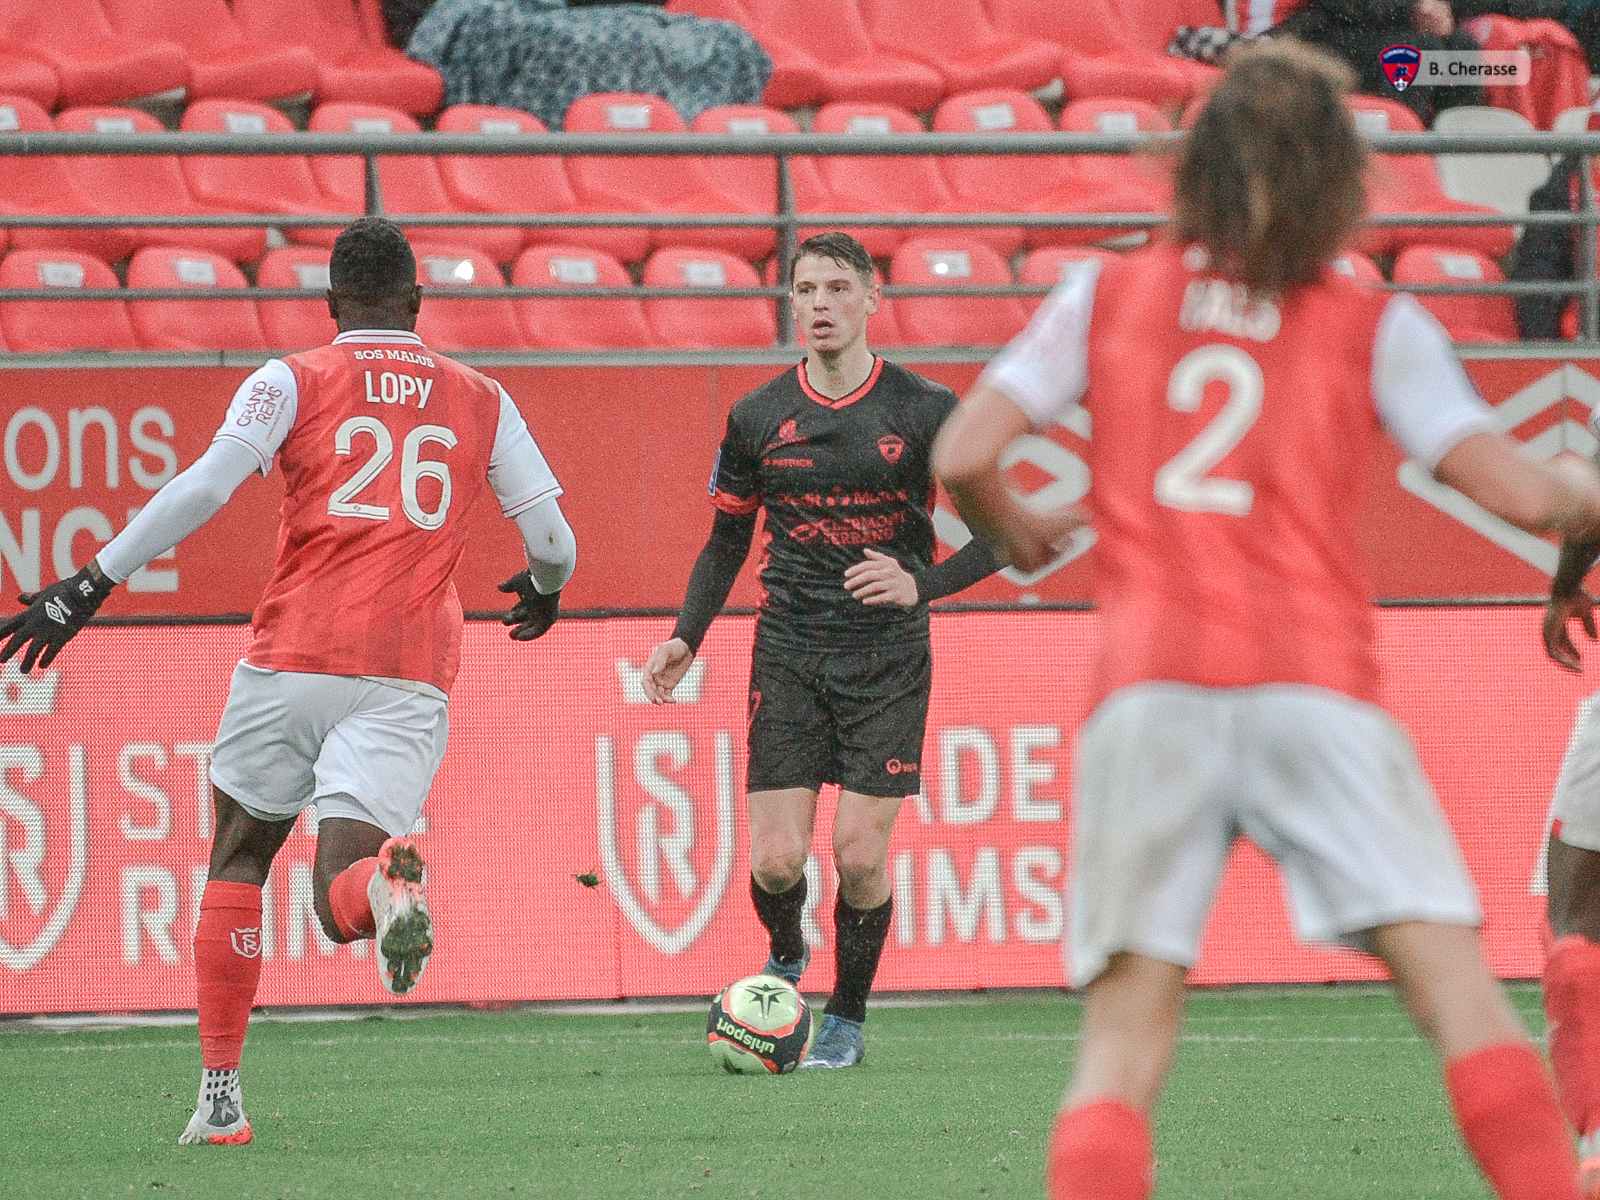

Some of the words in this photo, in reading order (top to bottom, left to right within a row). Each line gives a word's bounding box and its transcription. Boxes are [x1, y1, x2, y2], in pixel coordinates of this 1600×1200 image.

[354, 349, 385, 360] SOS
[385, 349, 436, 368] MALUS
[236, 380, 267, 427] GRAND
[255, 385, 282, 425] REIMS
[365, 370, 433, 409] LOPY
[1153, 342, 1265, 517] 2
[327, 415, 458, 531] 26
[53, 596, 72, 616] umbro
[78, 579, 94, 597] 28
[716, 1017, 776, 1054] uhlsport
